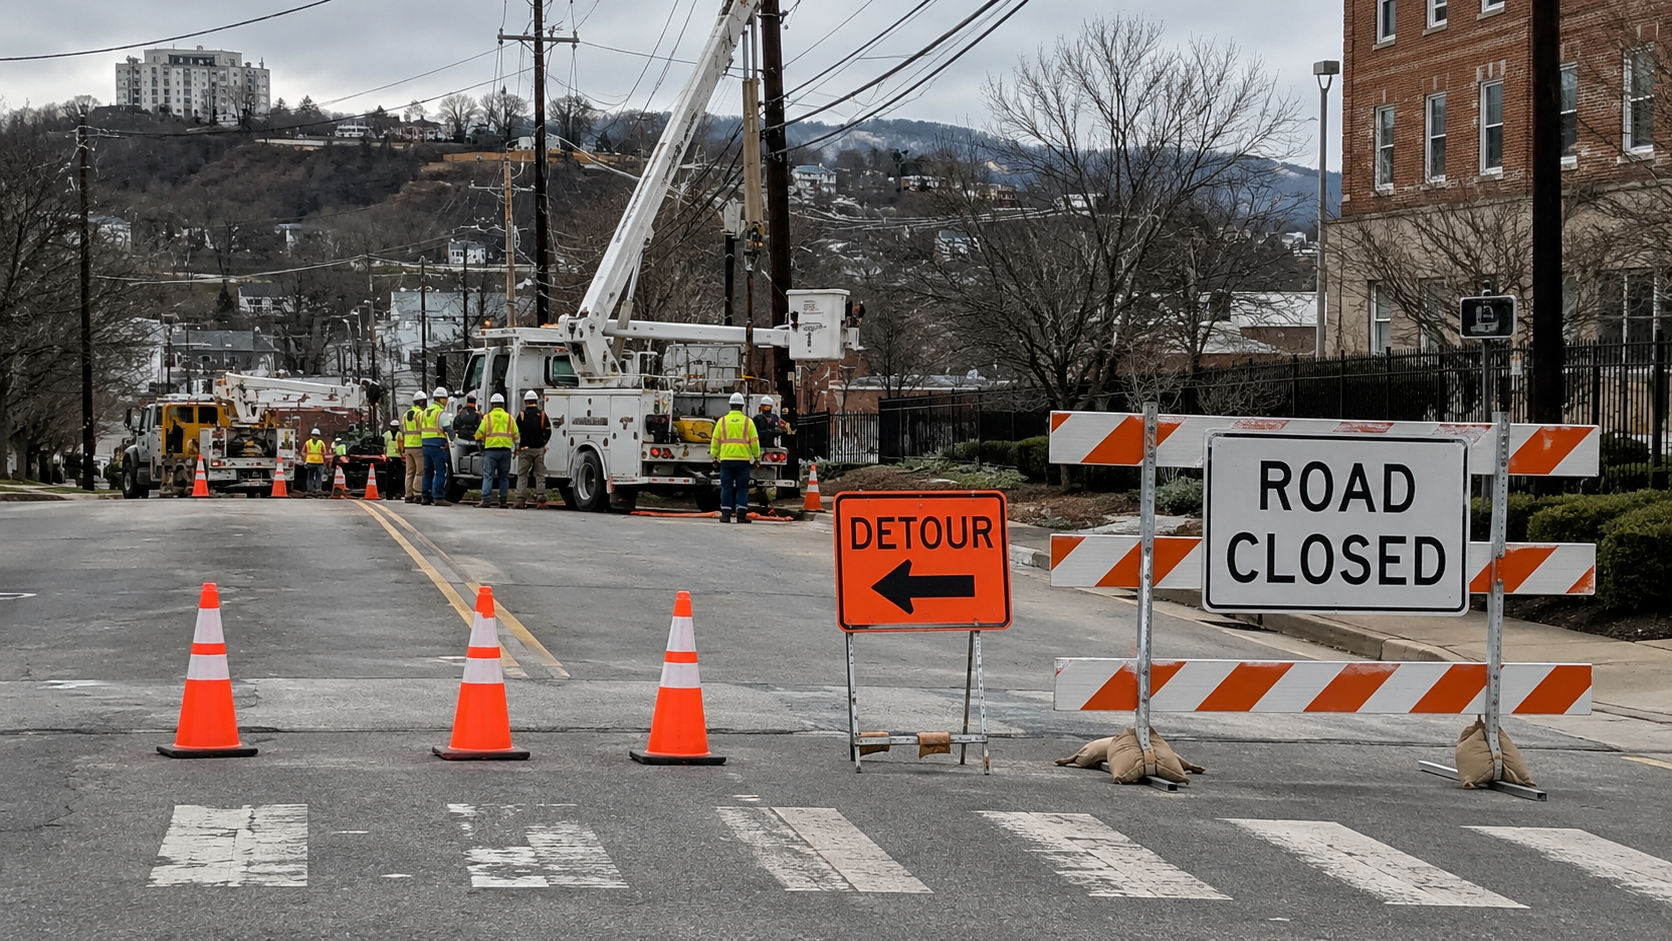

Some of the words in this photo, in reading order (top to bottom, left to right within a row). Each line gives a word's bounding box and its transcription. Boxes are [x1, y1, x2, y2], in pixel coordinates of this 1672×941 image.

[1259, 459, 1416, 514] ROAD
[850, 515, 994, 551] DETOUR
[1226, 531, 1446, 586] CLOSED
